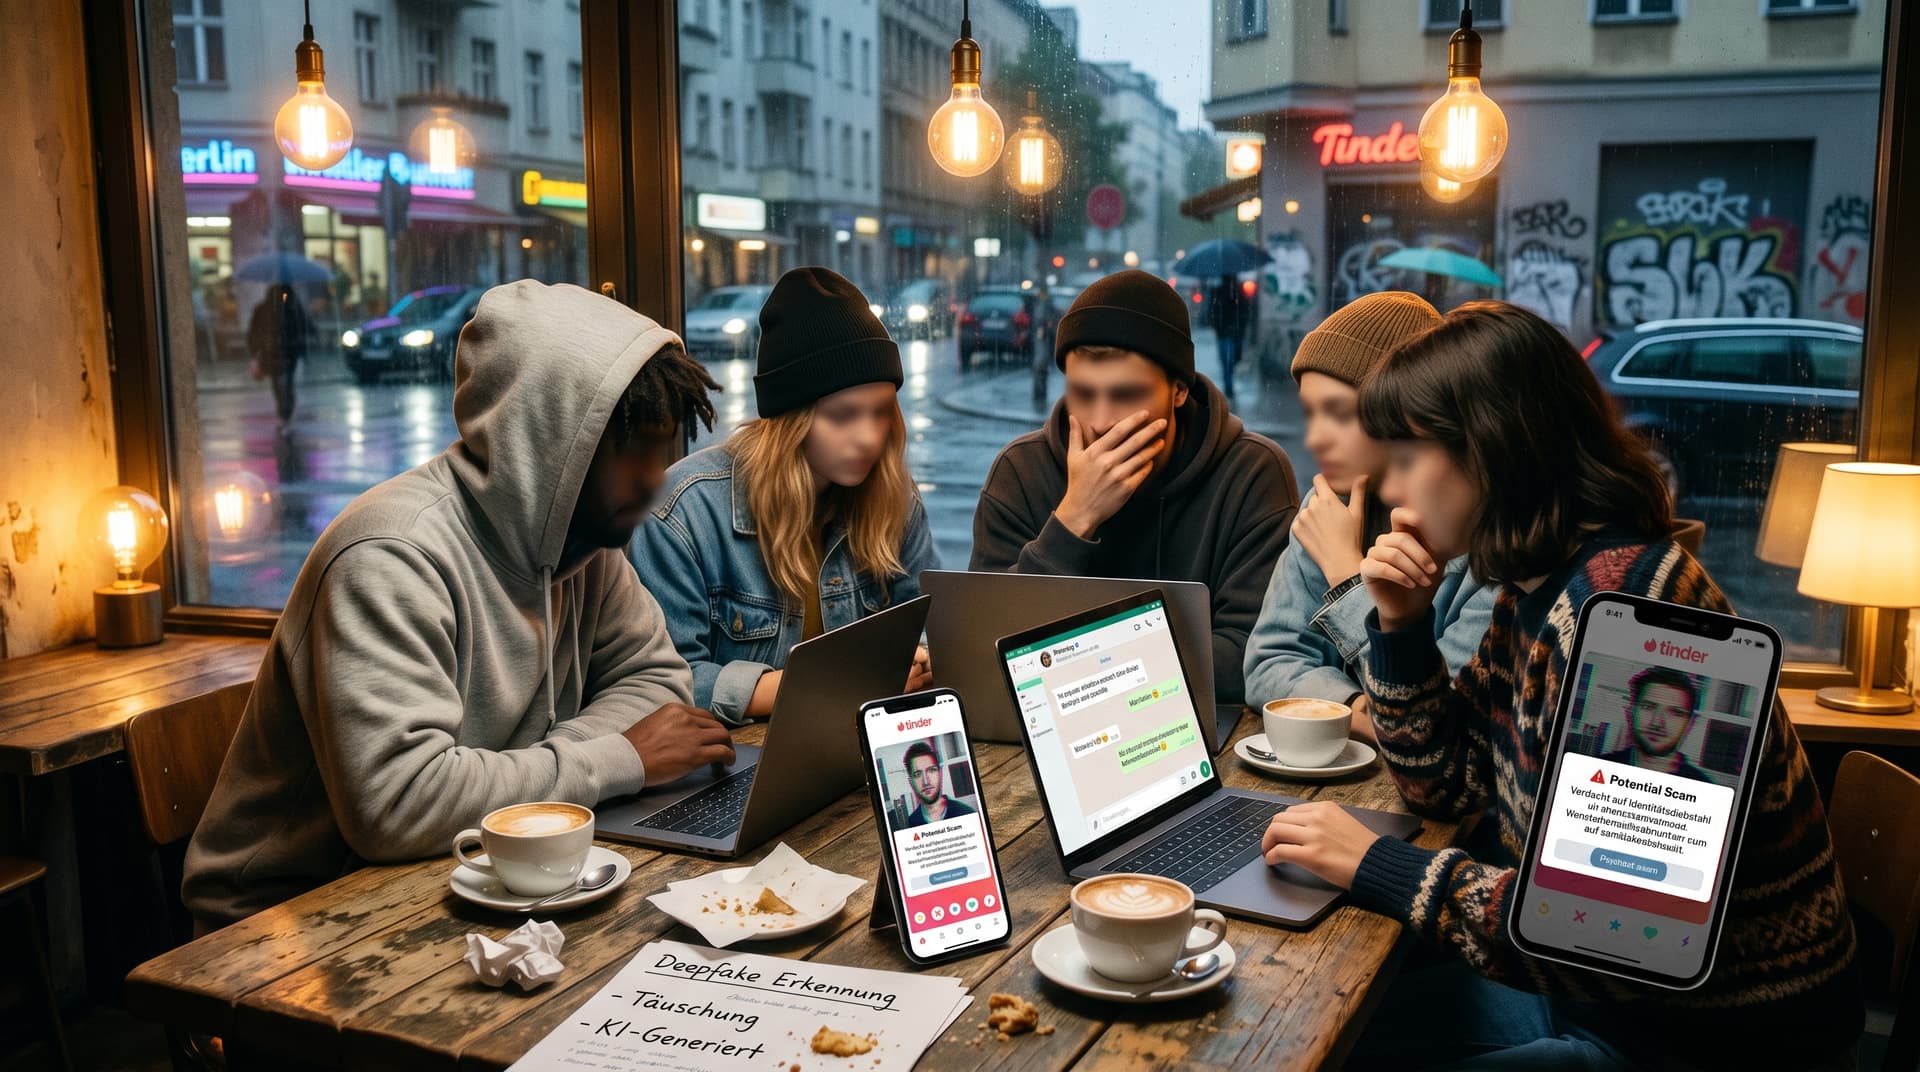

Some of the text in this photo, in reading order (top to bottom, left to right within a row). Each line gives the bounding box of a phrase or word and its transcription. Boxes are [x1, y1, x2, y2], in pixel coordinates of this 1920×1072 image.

[1312, 121, 1420, 167] Tinde
[1605, 608, 1623, 619] 9:41
[1659, 640, 1709, 664] tinder
[905, 717, 932, 730] tinder
[1570, 785, 1611, 803] Verdacht
[1611, 796, 1628, 807] auf
[1609, 774, 1697, 803] Potential Scam
[921, 827, 946, 839] Potential
[946, 824, 963, 833] Scam
[1584, 824, 1600, 835] auf
[653, 953, 762, 983] Deepfake
[772, 972, 897, 1011] Erkennung
[631, 990, 760, 1033] Täuschung
[595, 1017, 765, 1060] KI-Generiert
